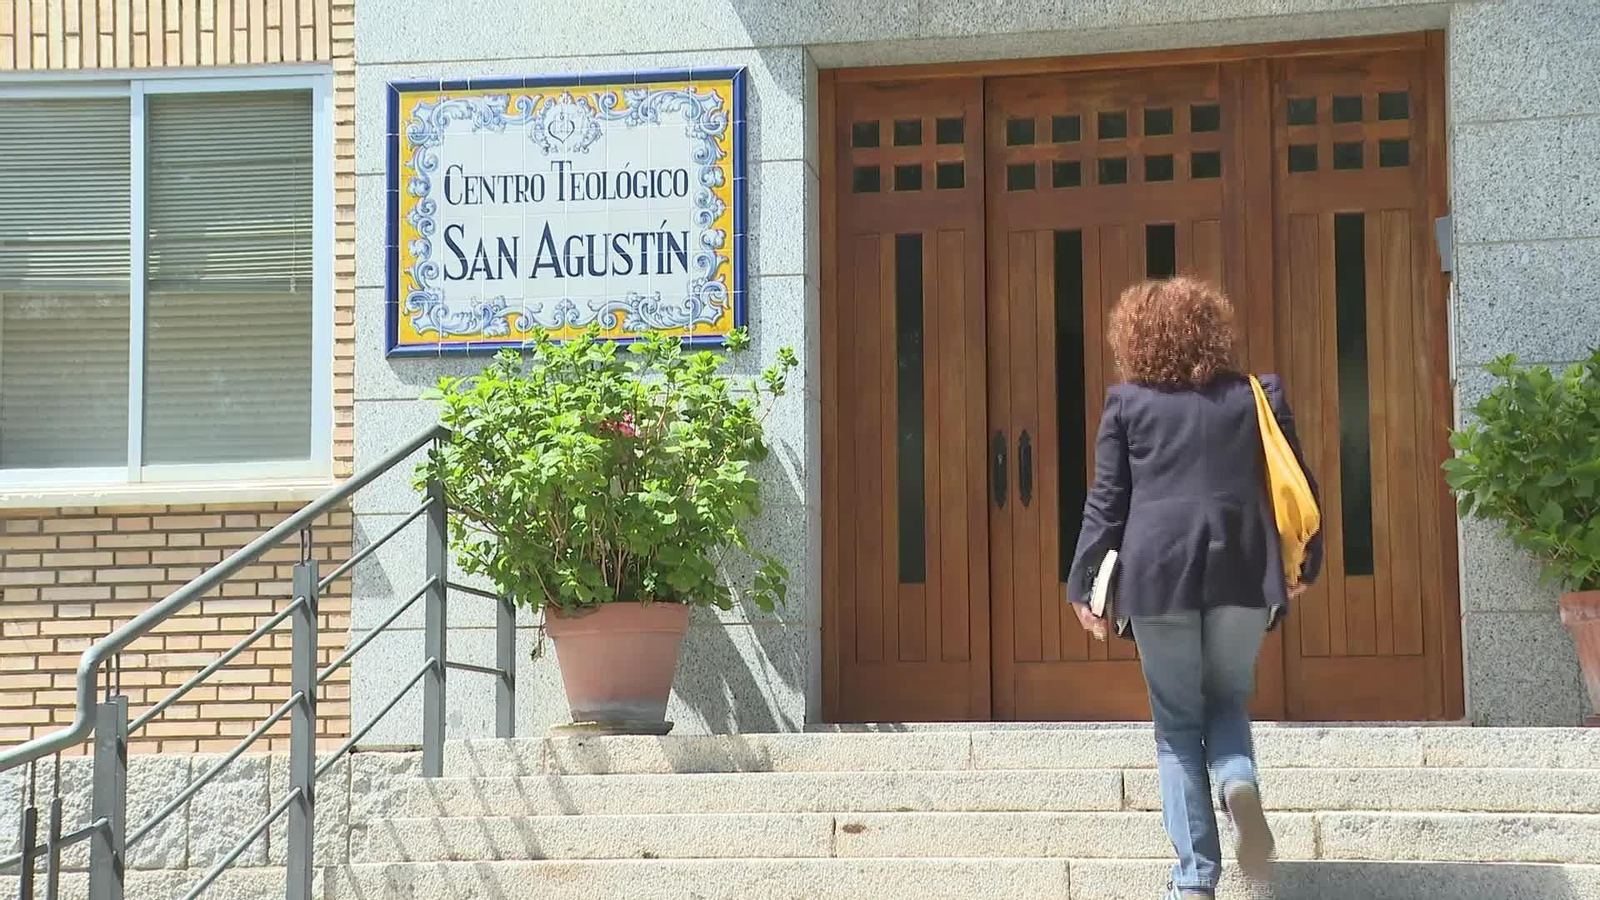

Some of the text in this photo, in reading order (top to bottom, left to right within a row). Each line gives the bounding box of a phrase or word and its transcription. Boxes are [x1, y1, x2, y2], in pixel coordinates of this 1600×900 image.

[444, 160, 689, 206] CENTRO TEOLÓGICO
[443, 220, 690, 281] SAN AGUSTÍN
